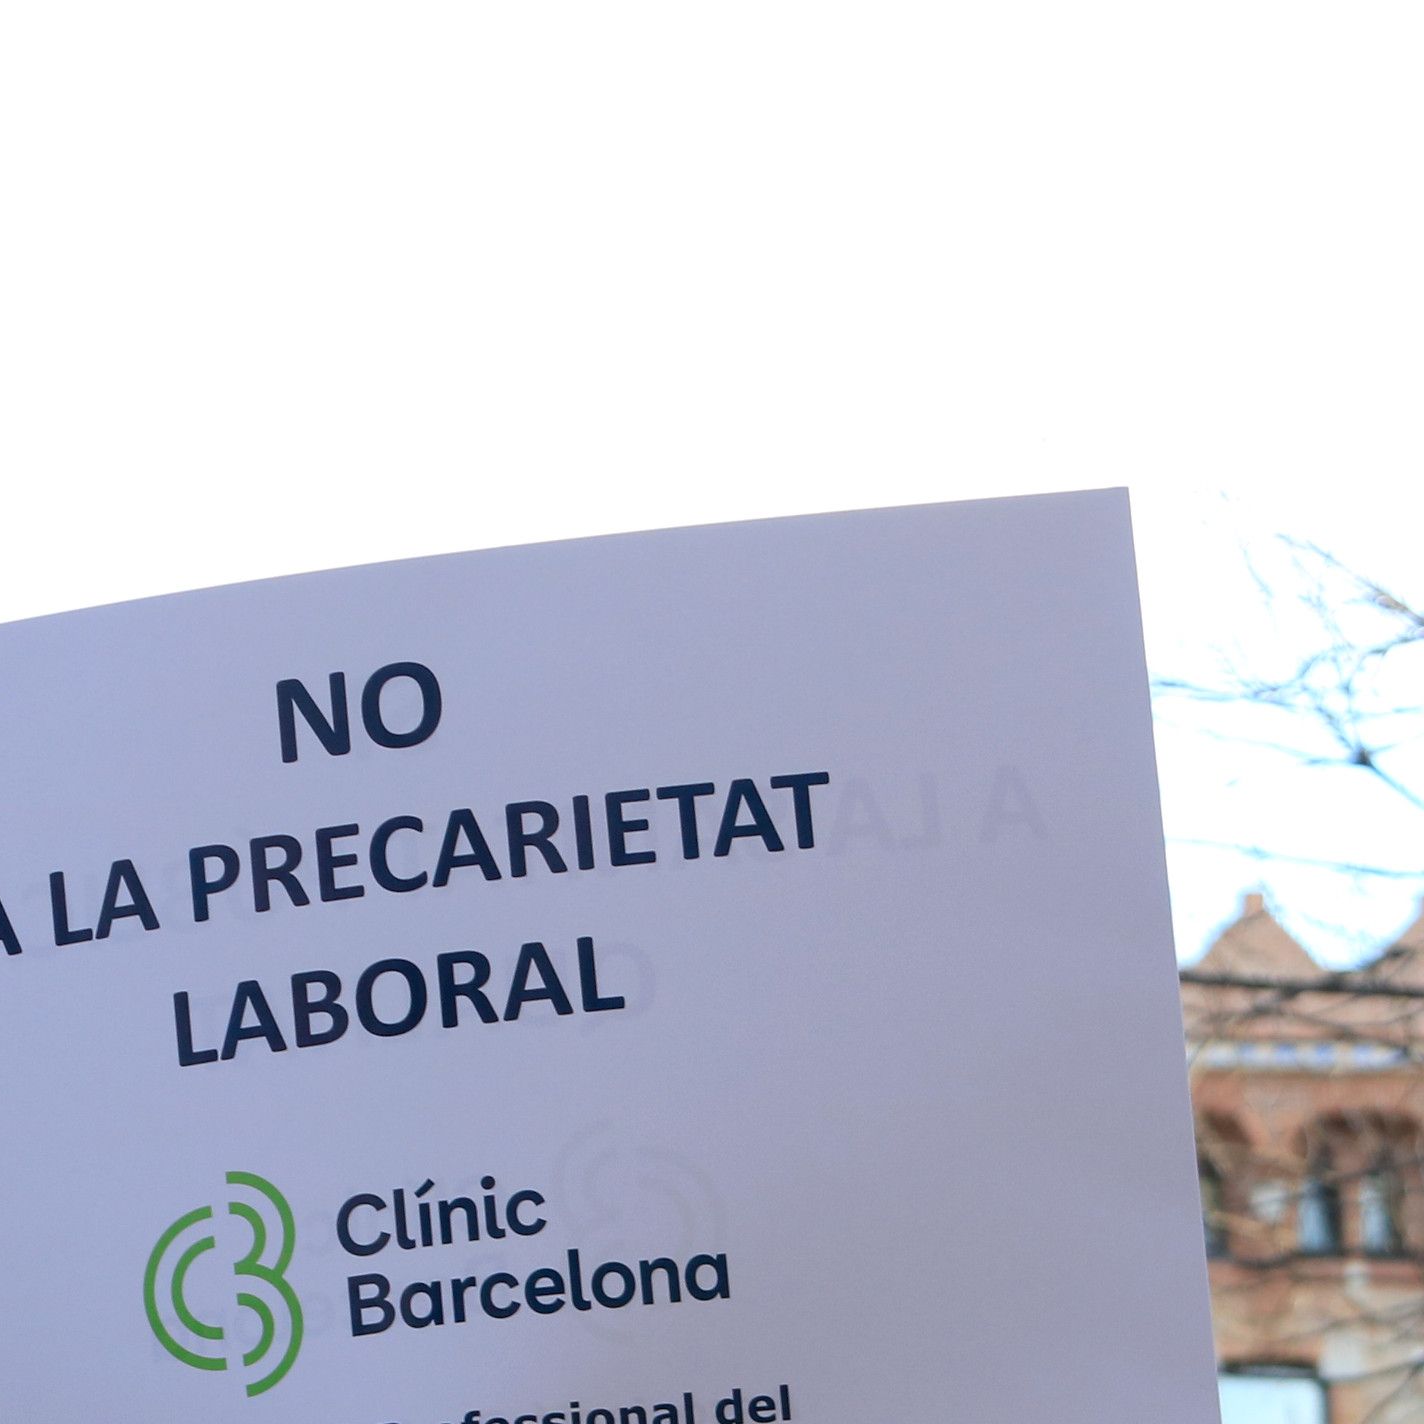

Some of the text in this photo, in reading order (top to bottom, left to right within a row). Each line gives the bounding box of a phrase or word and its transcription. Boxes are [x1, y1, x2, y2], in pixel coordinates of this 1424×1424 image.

[277, 662, 442, 763] NO
[50, 859, 160, 946] LA
[189, 772, 829, 922] PRECARIETAT
[174, 937, 625, 1067] LABORAL
[337, 1176, 547, 1256] Clínic
[348, 1249, 730, 1336] Barcelona
